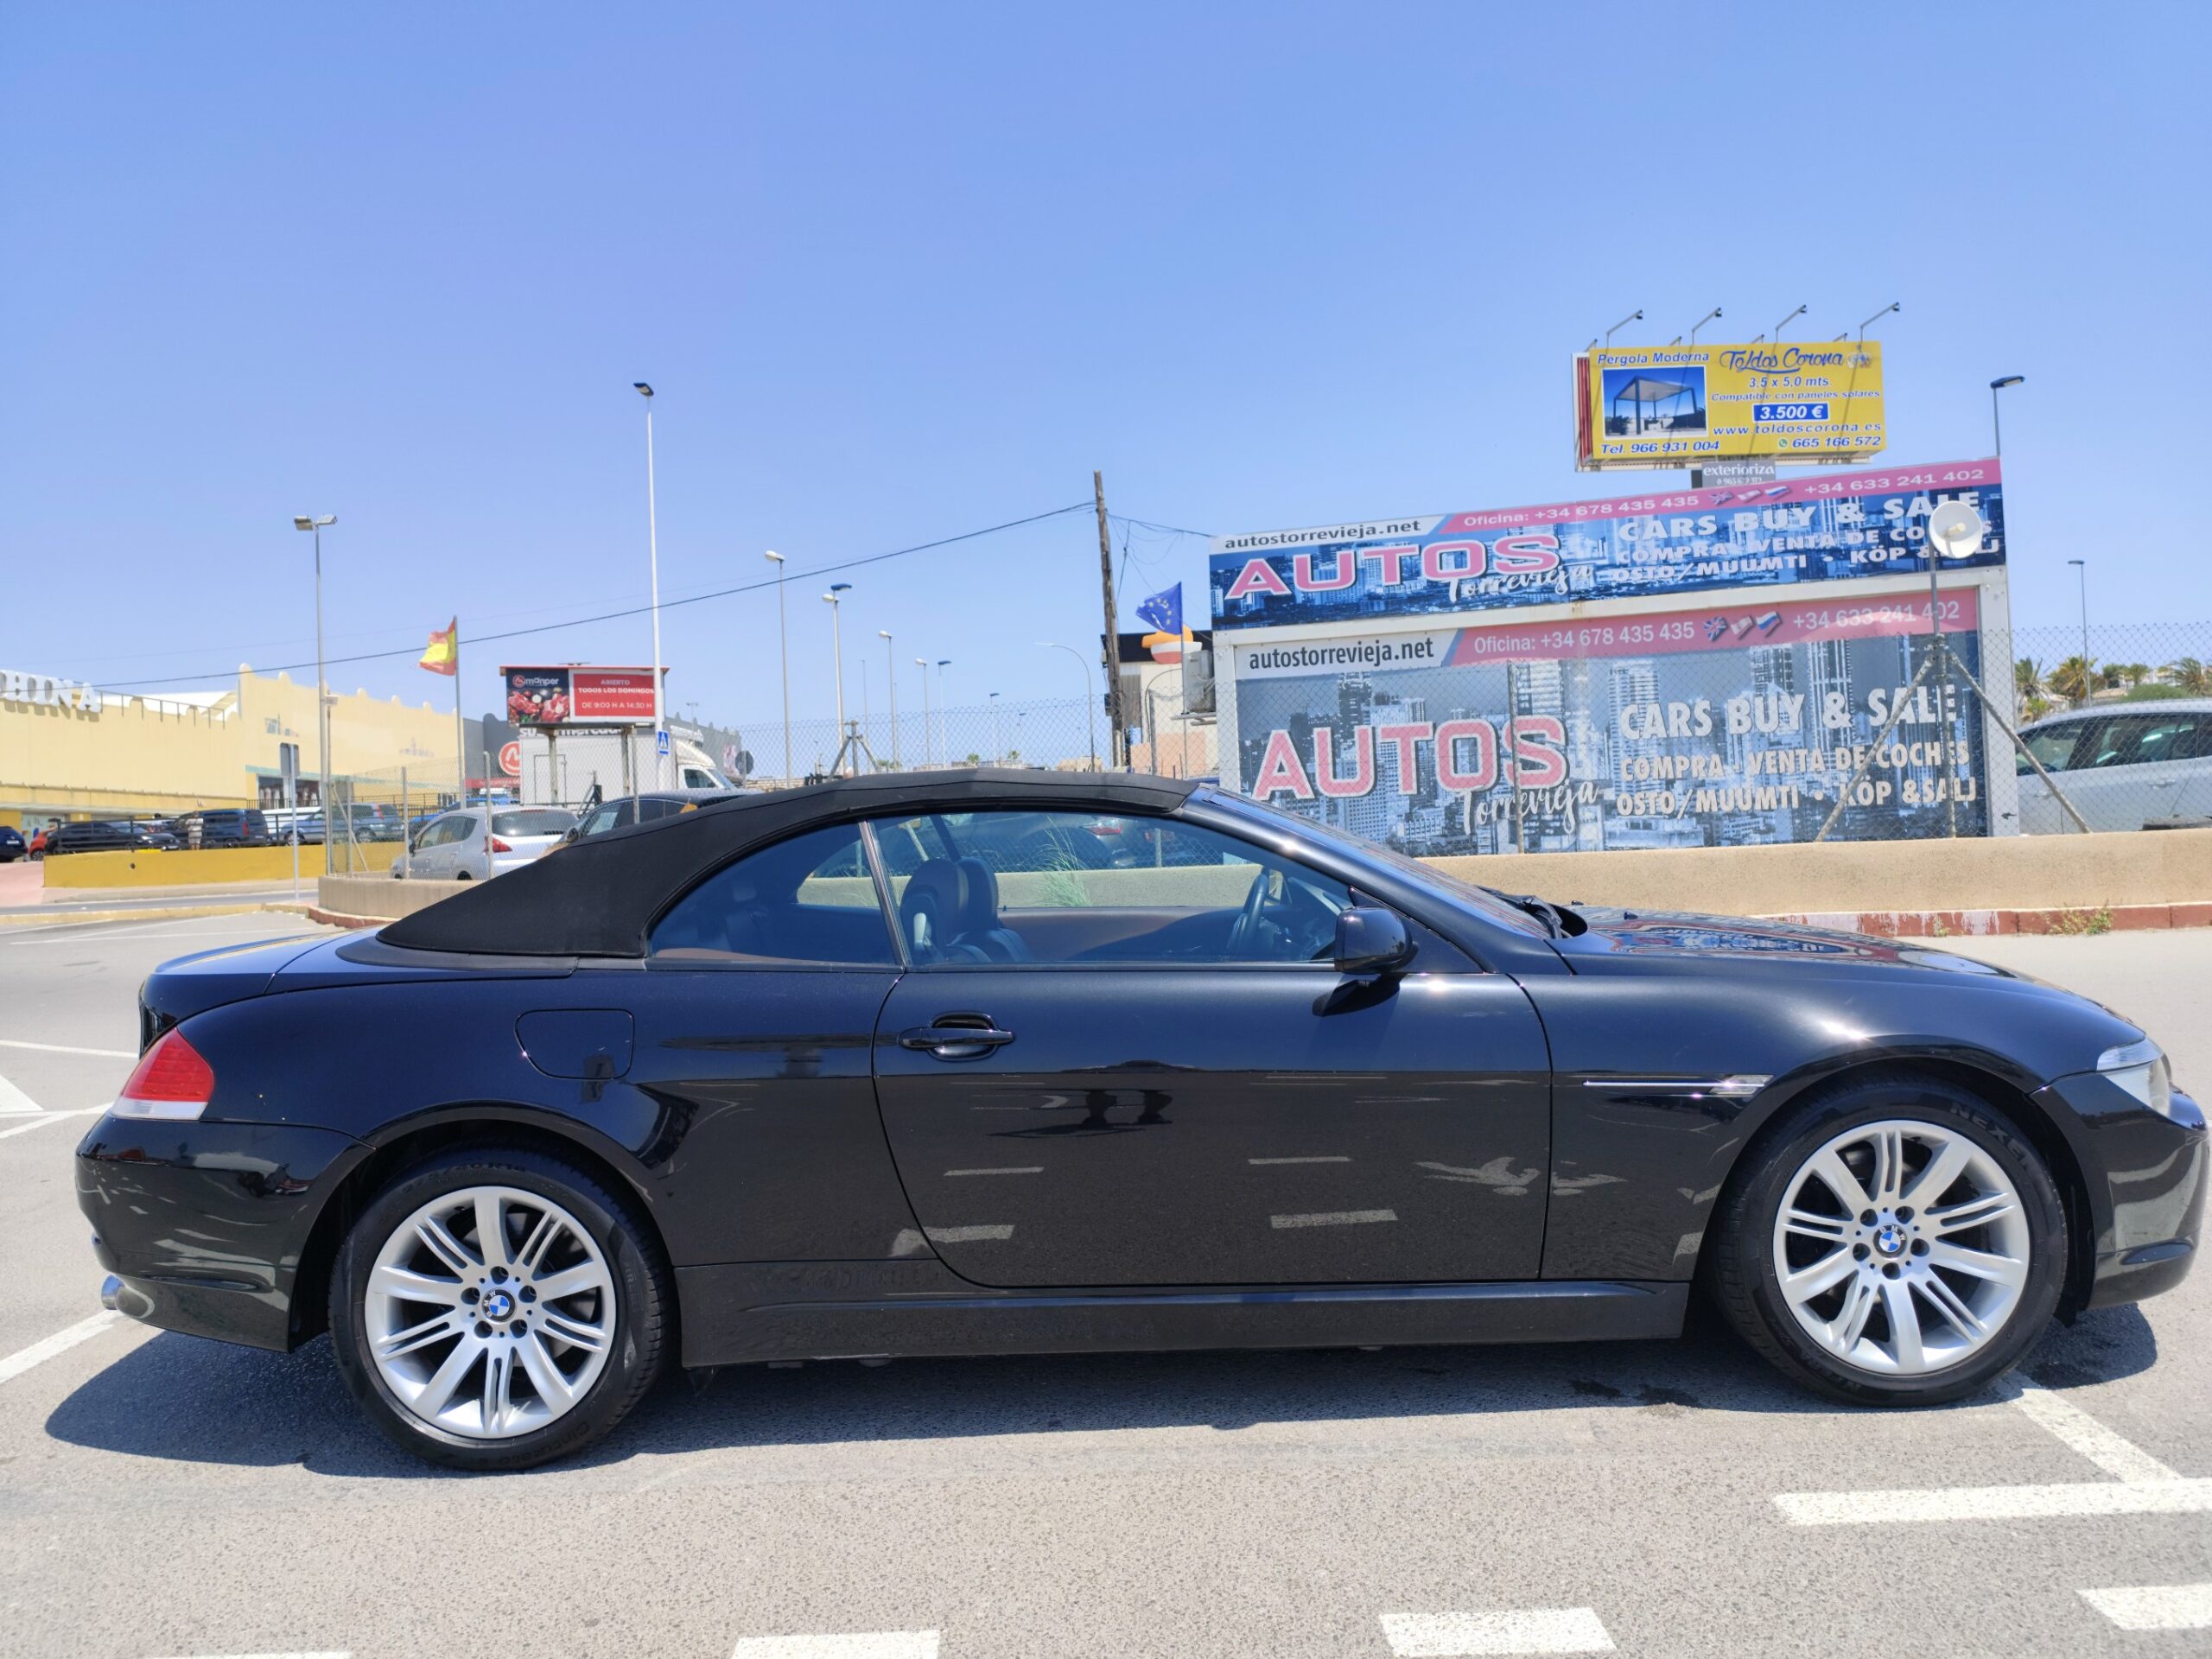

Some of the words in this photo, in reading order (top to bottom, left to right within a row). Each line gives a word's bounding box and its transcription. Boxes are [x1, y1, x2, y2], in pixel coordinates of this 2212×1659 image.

[1597, 353, 1647, 366] Pergola
[1652, 353, 1710, 364] Moderna
[1783, 347, 1844, 369] Corona
[1712, 392, 1770, 402] Compatible
[1797, 391, 1839, 401] paneles
[1759, 405, 1808, 420] 3.500
[1811, 404, 1823, 418] €
[1630, 442, 1657, 454] 966
[1662, 442, 1688, 453] 931
[1693, 440, 1719, 451] 004
[1792, 437, 1820, 448] 665
[1825, 437, 1850, 448] 166
[1854, 435, 1881, 446] 572
[1703, 463, 1775, 476] exterioriza
[1804, 481, 1844, 494] +34
[1849, 478, 1891, 491] 633
[1897, 474, 1936, 486] 241
[1942, 469, 1984, 481] 402
[1464, 512, 1529, 526] Oficina:
[1535, 508, 1570, 520] +34
[1575, 503, 1612, 516] 678
[1618, 499, 1656, 512] 435
[1661, 495, 1699, 508] 435
[1619, 514, 1718, 541] CARS
[1733, 506, 1816, 531] BUY
[1835, 502, 1866, 524] &
[1224, 518, 1421, 549] autostorrevieja.net
[1618, 542, 1729, 563] COMPRA
[1847, 530, 1879, 544] DE
[1224, 534, 1560, 601] AUTOS
[1850, 545, 1906, 564] KÖP
[1793, 610, 1830, 630] +34
[1835, 608, 1874, 627] 633
[1879, 604, 1917, 622] 241
[1922, 601, 1961, 620] 402
[1474, 635, 1535, 653] Oficina:
[1541, 630, 1574, 648] +34
[1580, 627, 1614, 646] 678
[1619, 625, 1654, 643] 435
[1659, 621, 1694, 639] 435
[1249, 638, 1434, 670] autostorrevieja.net
[525, 677, 559, 686] manper
[1620, 700, 1713, 740] CARS
[1728, 694, 1805, 734] BUY
[1823, 691, 1853, 728] &
[1868, 684, 1957, 727] SALE
[1251, 715, 1567, 801] AUTOS
[1620, 753, 1725, 781] COMPRA
[1748, 747, 1827, 775] VENTA
[1835, 746, 1866, 770] DE
[1876, 741, 1970, 768] COCHES
